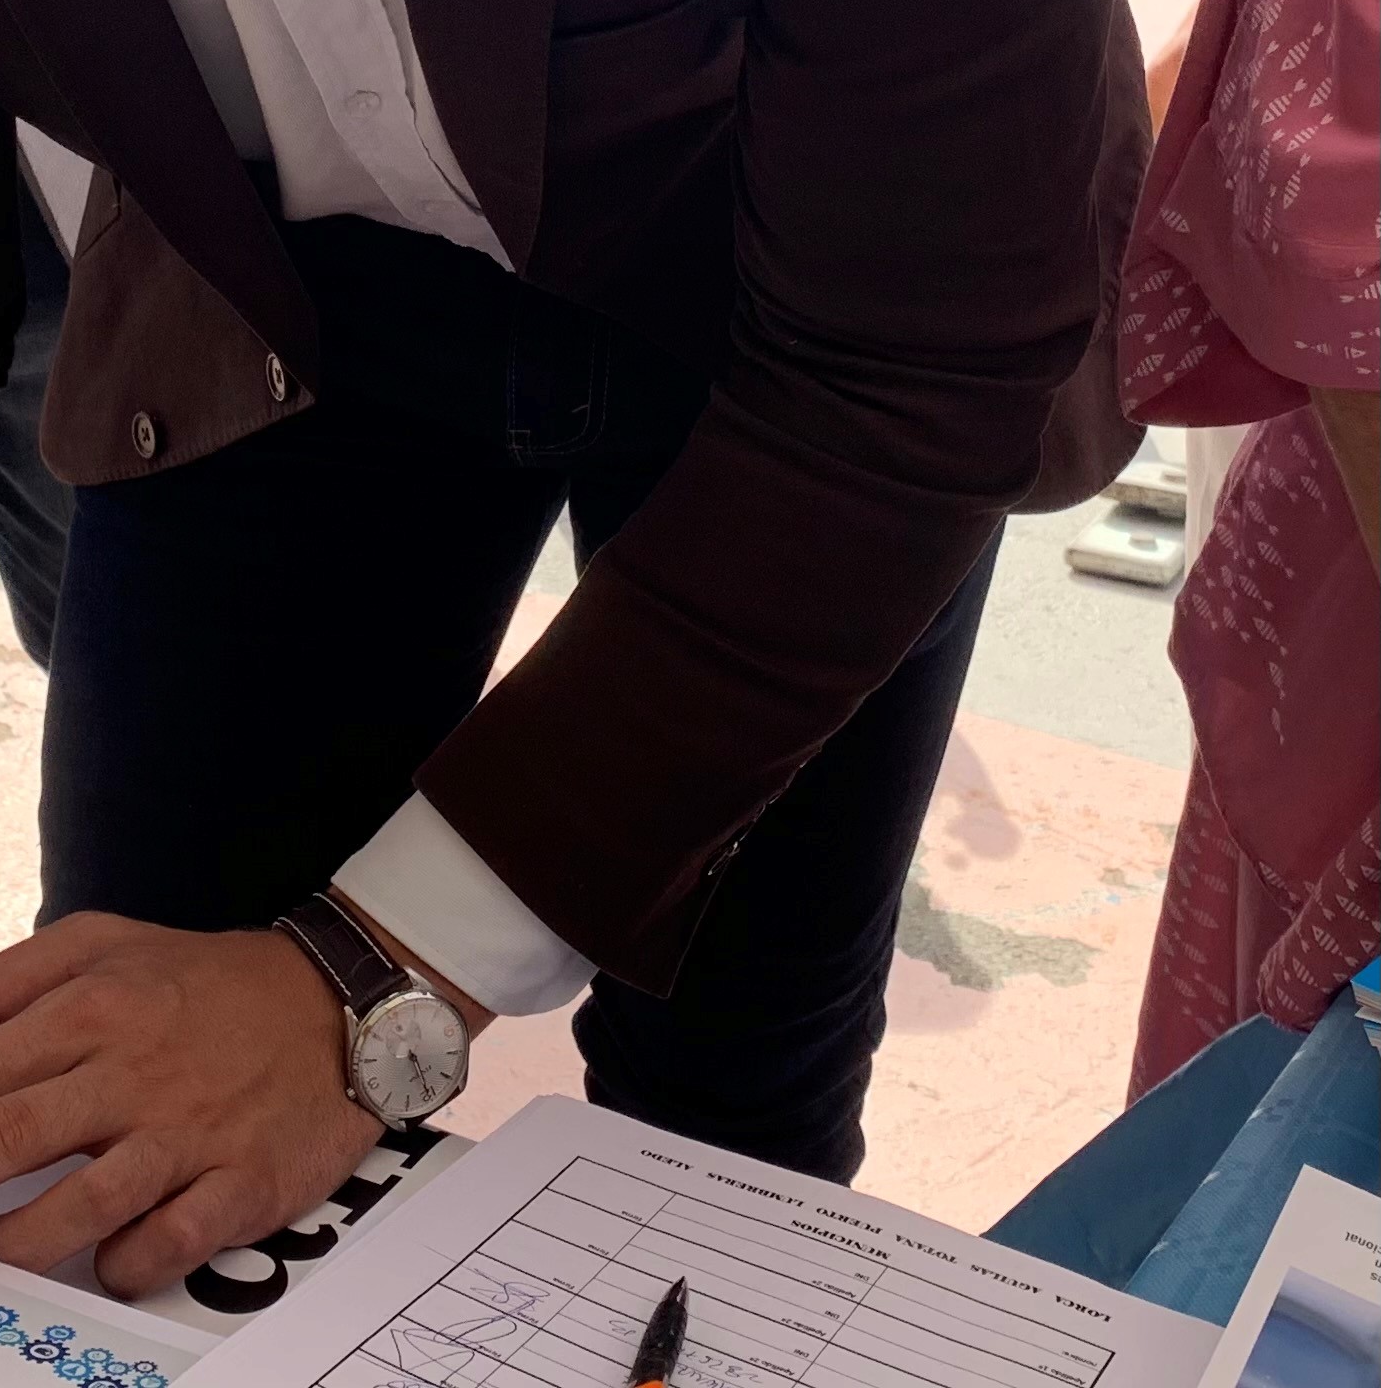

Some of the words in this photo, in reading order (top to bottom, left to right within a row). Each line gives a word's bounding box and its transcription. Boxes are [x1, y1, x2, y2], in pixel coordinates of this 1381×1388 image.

[640, 1148, 694, 1173] ALEDO
[706, 1171, 804, 1209] LUMBRERAS
[815, 1206, 883, 1236] PUERTO
[790, 1219, 891, 1261] MUNICIPIOS
[894, 1233, 958, 1265] TOTANA
[552, 1276, 576, 1291] Firma
[823, 1282, 857, 1300] Apellido
[970, 1263, 1043, 1295] AGUILAS
[1055, 1294, 1112, 1323] LORCA
[793, 1320, 827, 1338] Apellido
[761, 1358, 796, 1378] Apellido
[1050, 1368, 1086, 1386] Apellido
